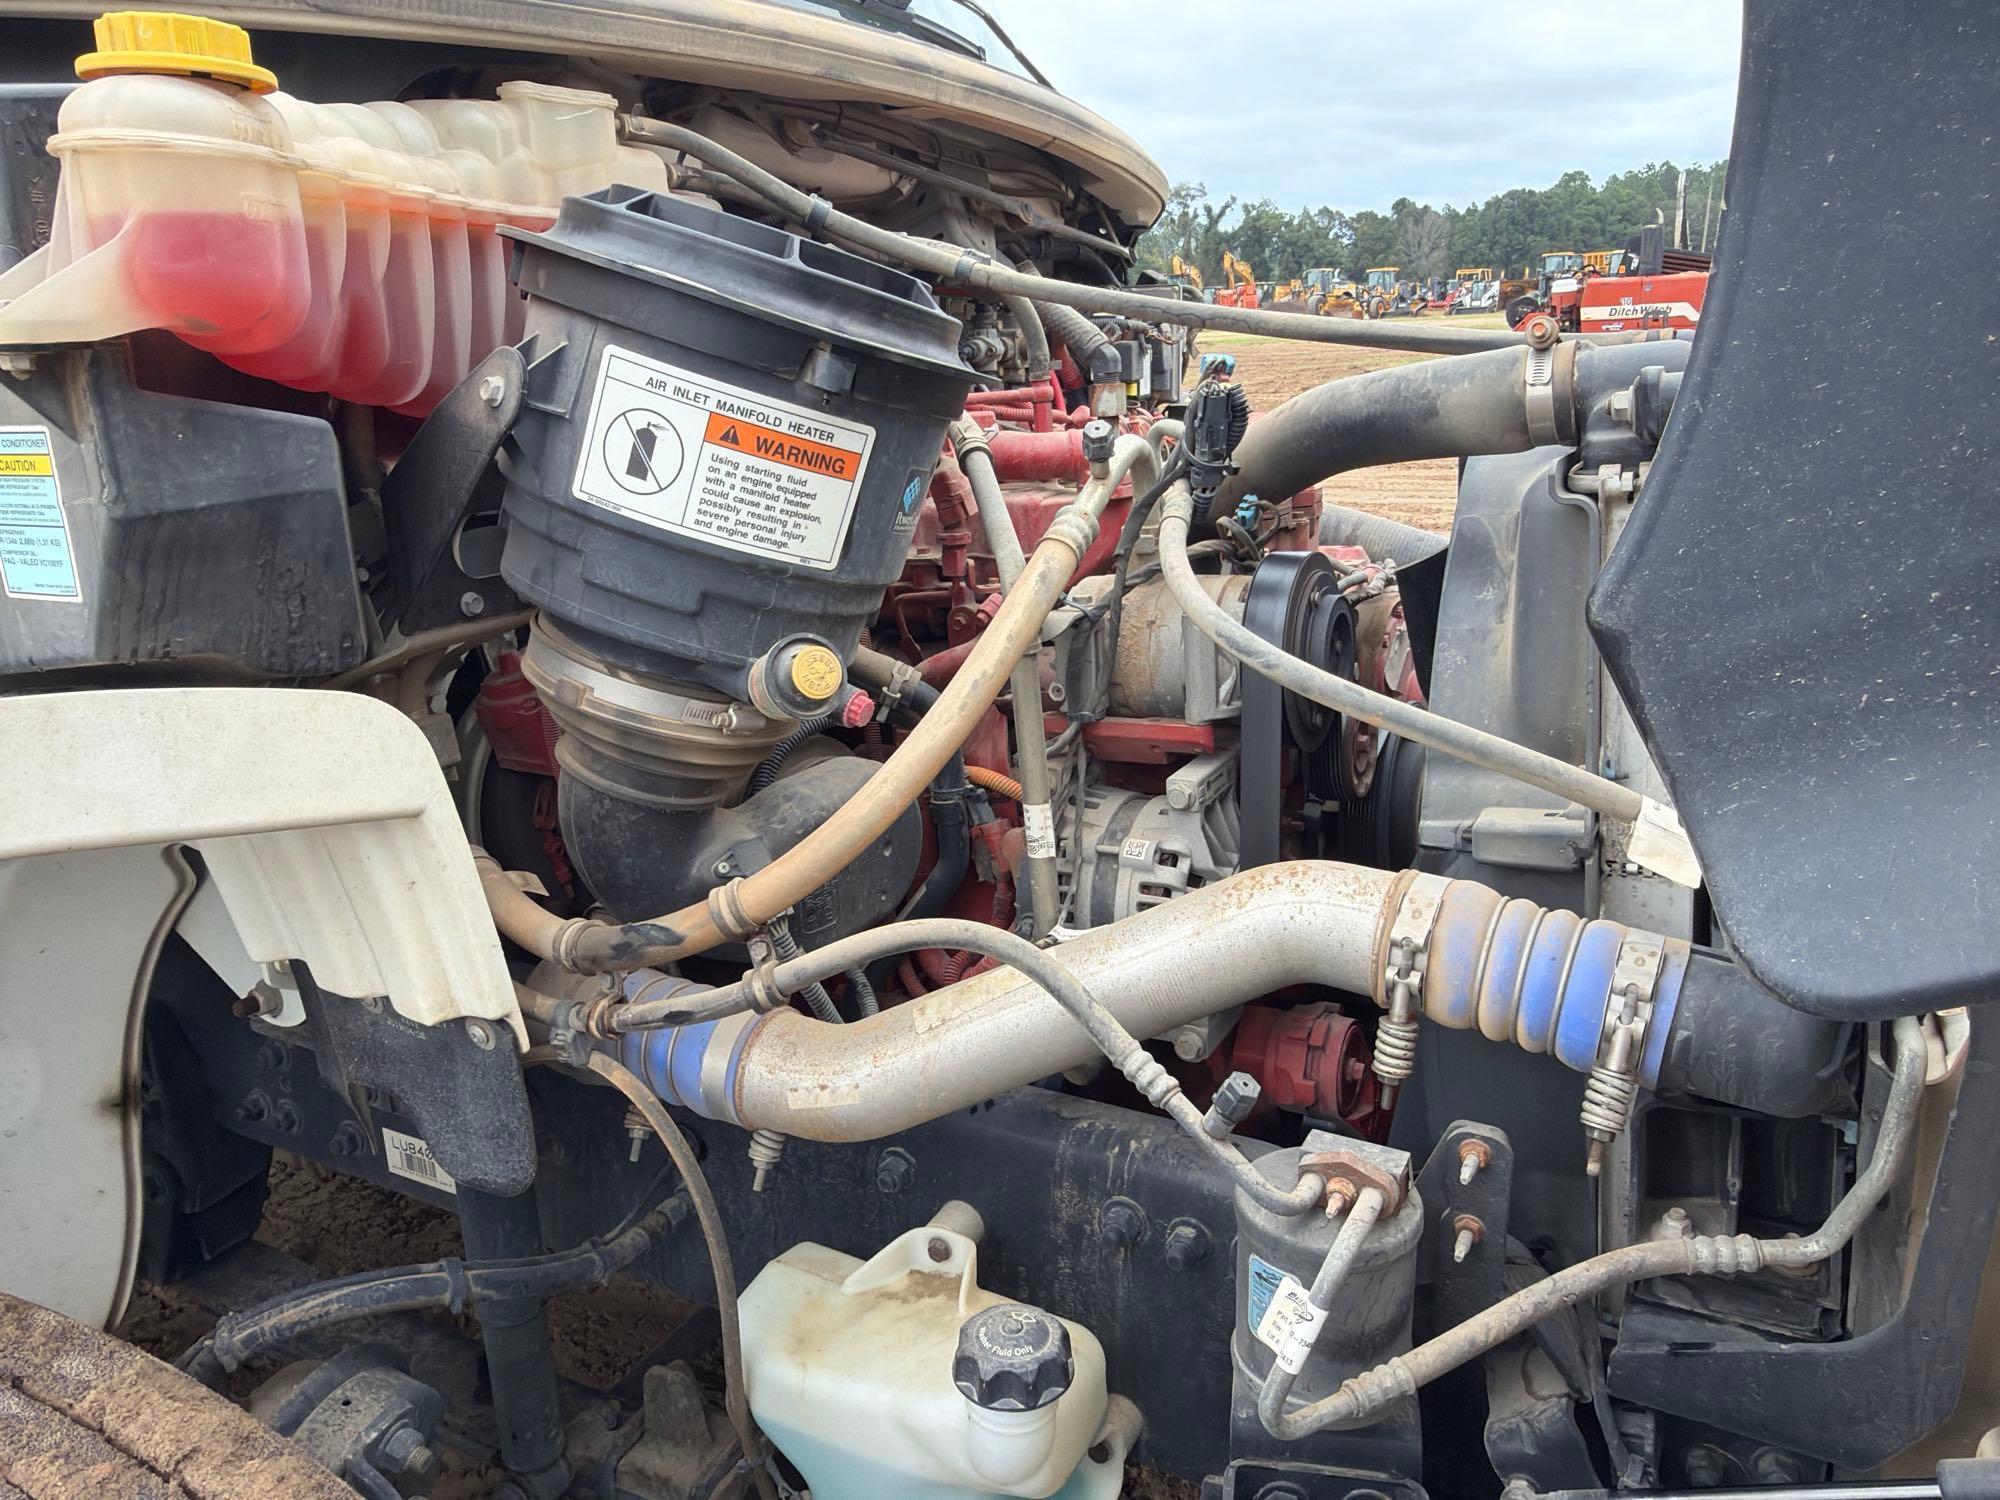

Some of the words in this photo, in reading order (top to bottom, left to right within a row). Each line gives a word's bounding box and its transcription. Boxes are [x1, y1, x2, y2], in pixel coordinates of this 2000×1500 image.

[1609, 306, 1639, 317] Ditch
[645, 376, 667, 392] AIR
[672, 385, 710, 406] INLET
[716, 399, 782, 428] MANIFOLD
[788, 421, 836, 443] HEATER
[1, 439, 46, 448] CONDITIONER
[756, 436, 846, 475] WARNING
[0, 460, 36, 472] CAUTION
[708, 465, 721, 476] on
[724, 470, 737, 480] an
[740, 474, 773, 490] engine
[776, 484, 818, 501] equipped
[711, 453, 740, 471] Using
[744, 463, 782, 482] starting
[786, 474, 808, 488] fluid
[702, 486, 729, 500] could
[732, 495, 761, 509] cause
[764, 503, 776, 512] an
[779, 507, 822, 525] explosion,
[705, 475, 726, 488] with
[740, 485, 780, 503] manifold
[783, 497, 812, 510] heater
[696, 508, 730, 522] severe
[734, 518, 777, 535] personal
[780, 528, 807, 544] injury
[698, 496, 742, 516] possibly
[746, 509, 789, 529] resulting
[792, 520, 802, 530] in
[694, 518, 713, 530] and
[716, 524, 749, 540] engine
[752, 533, 790, 550] damage.
[19, 558, 38, 566] VALEO
[991, 1345, 1012, 1356] Fluid
[1014, 1344, 1034, 1356] Only
